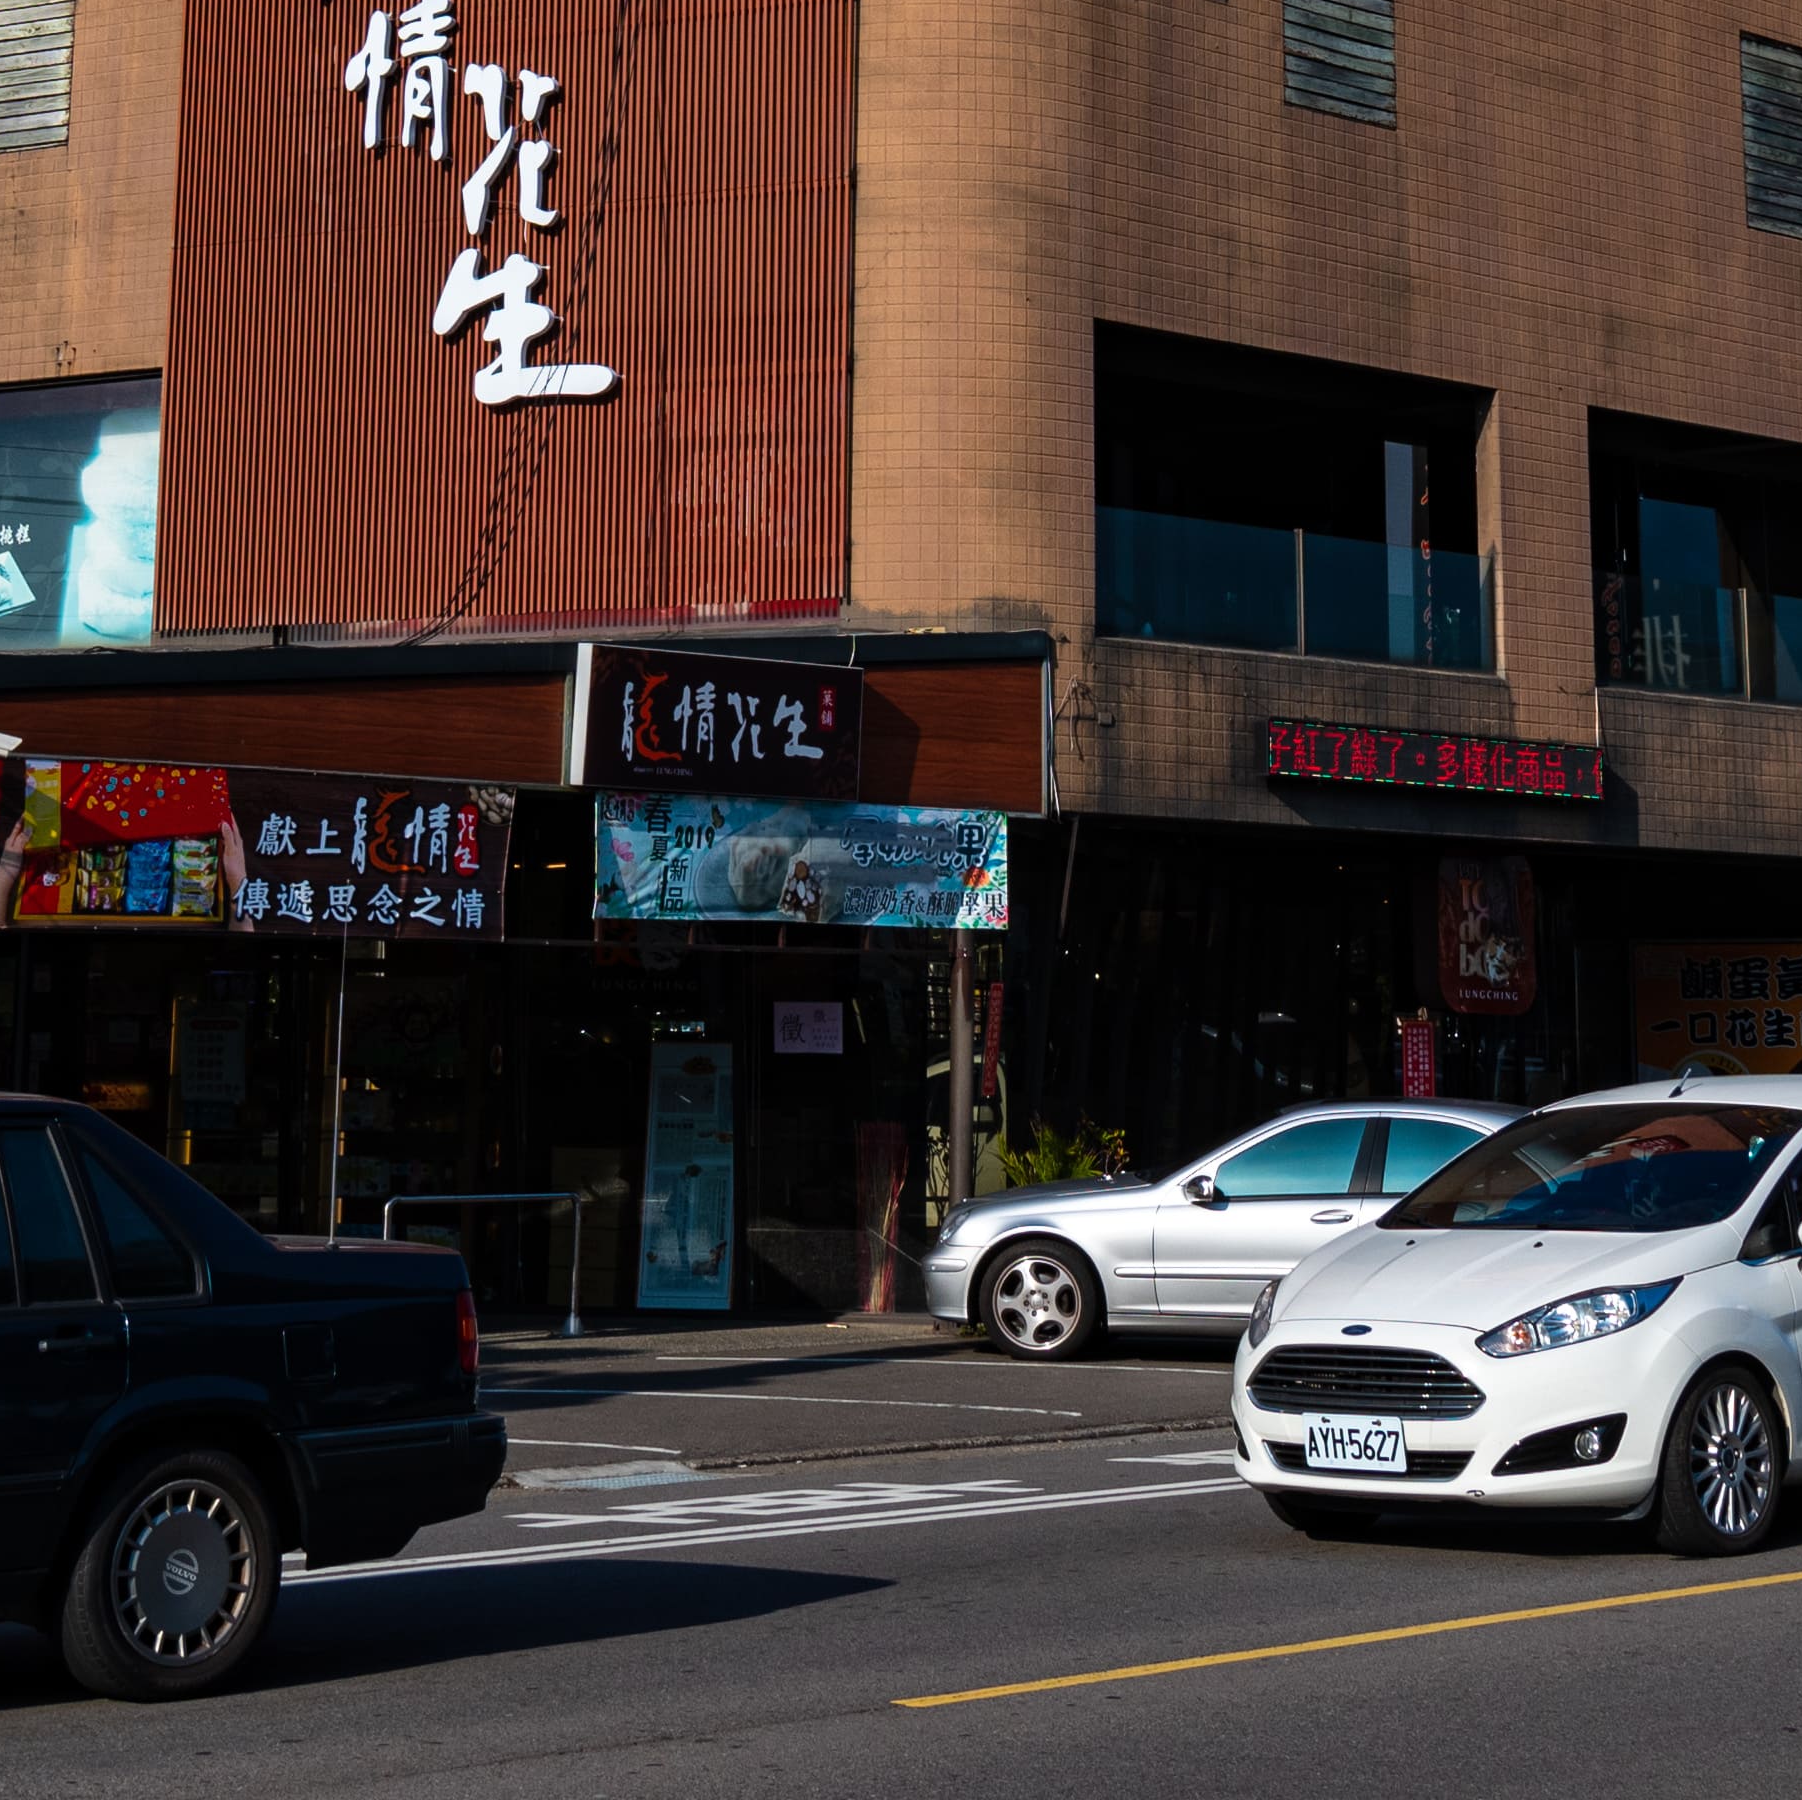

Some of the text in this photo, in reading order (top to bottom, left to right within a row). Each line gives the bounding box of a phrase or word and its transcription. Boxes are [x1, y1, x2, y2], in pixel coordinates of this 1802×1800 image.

[621, 672, 824, 762] 龍情花生
[674, 825, 716, 849] 2019
[233, 877, 486, 930] 傳遞思念之情
[665, 858, 689, 913] 新品
